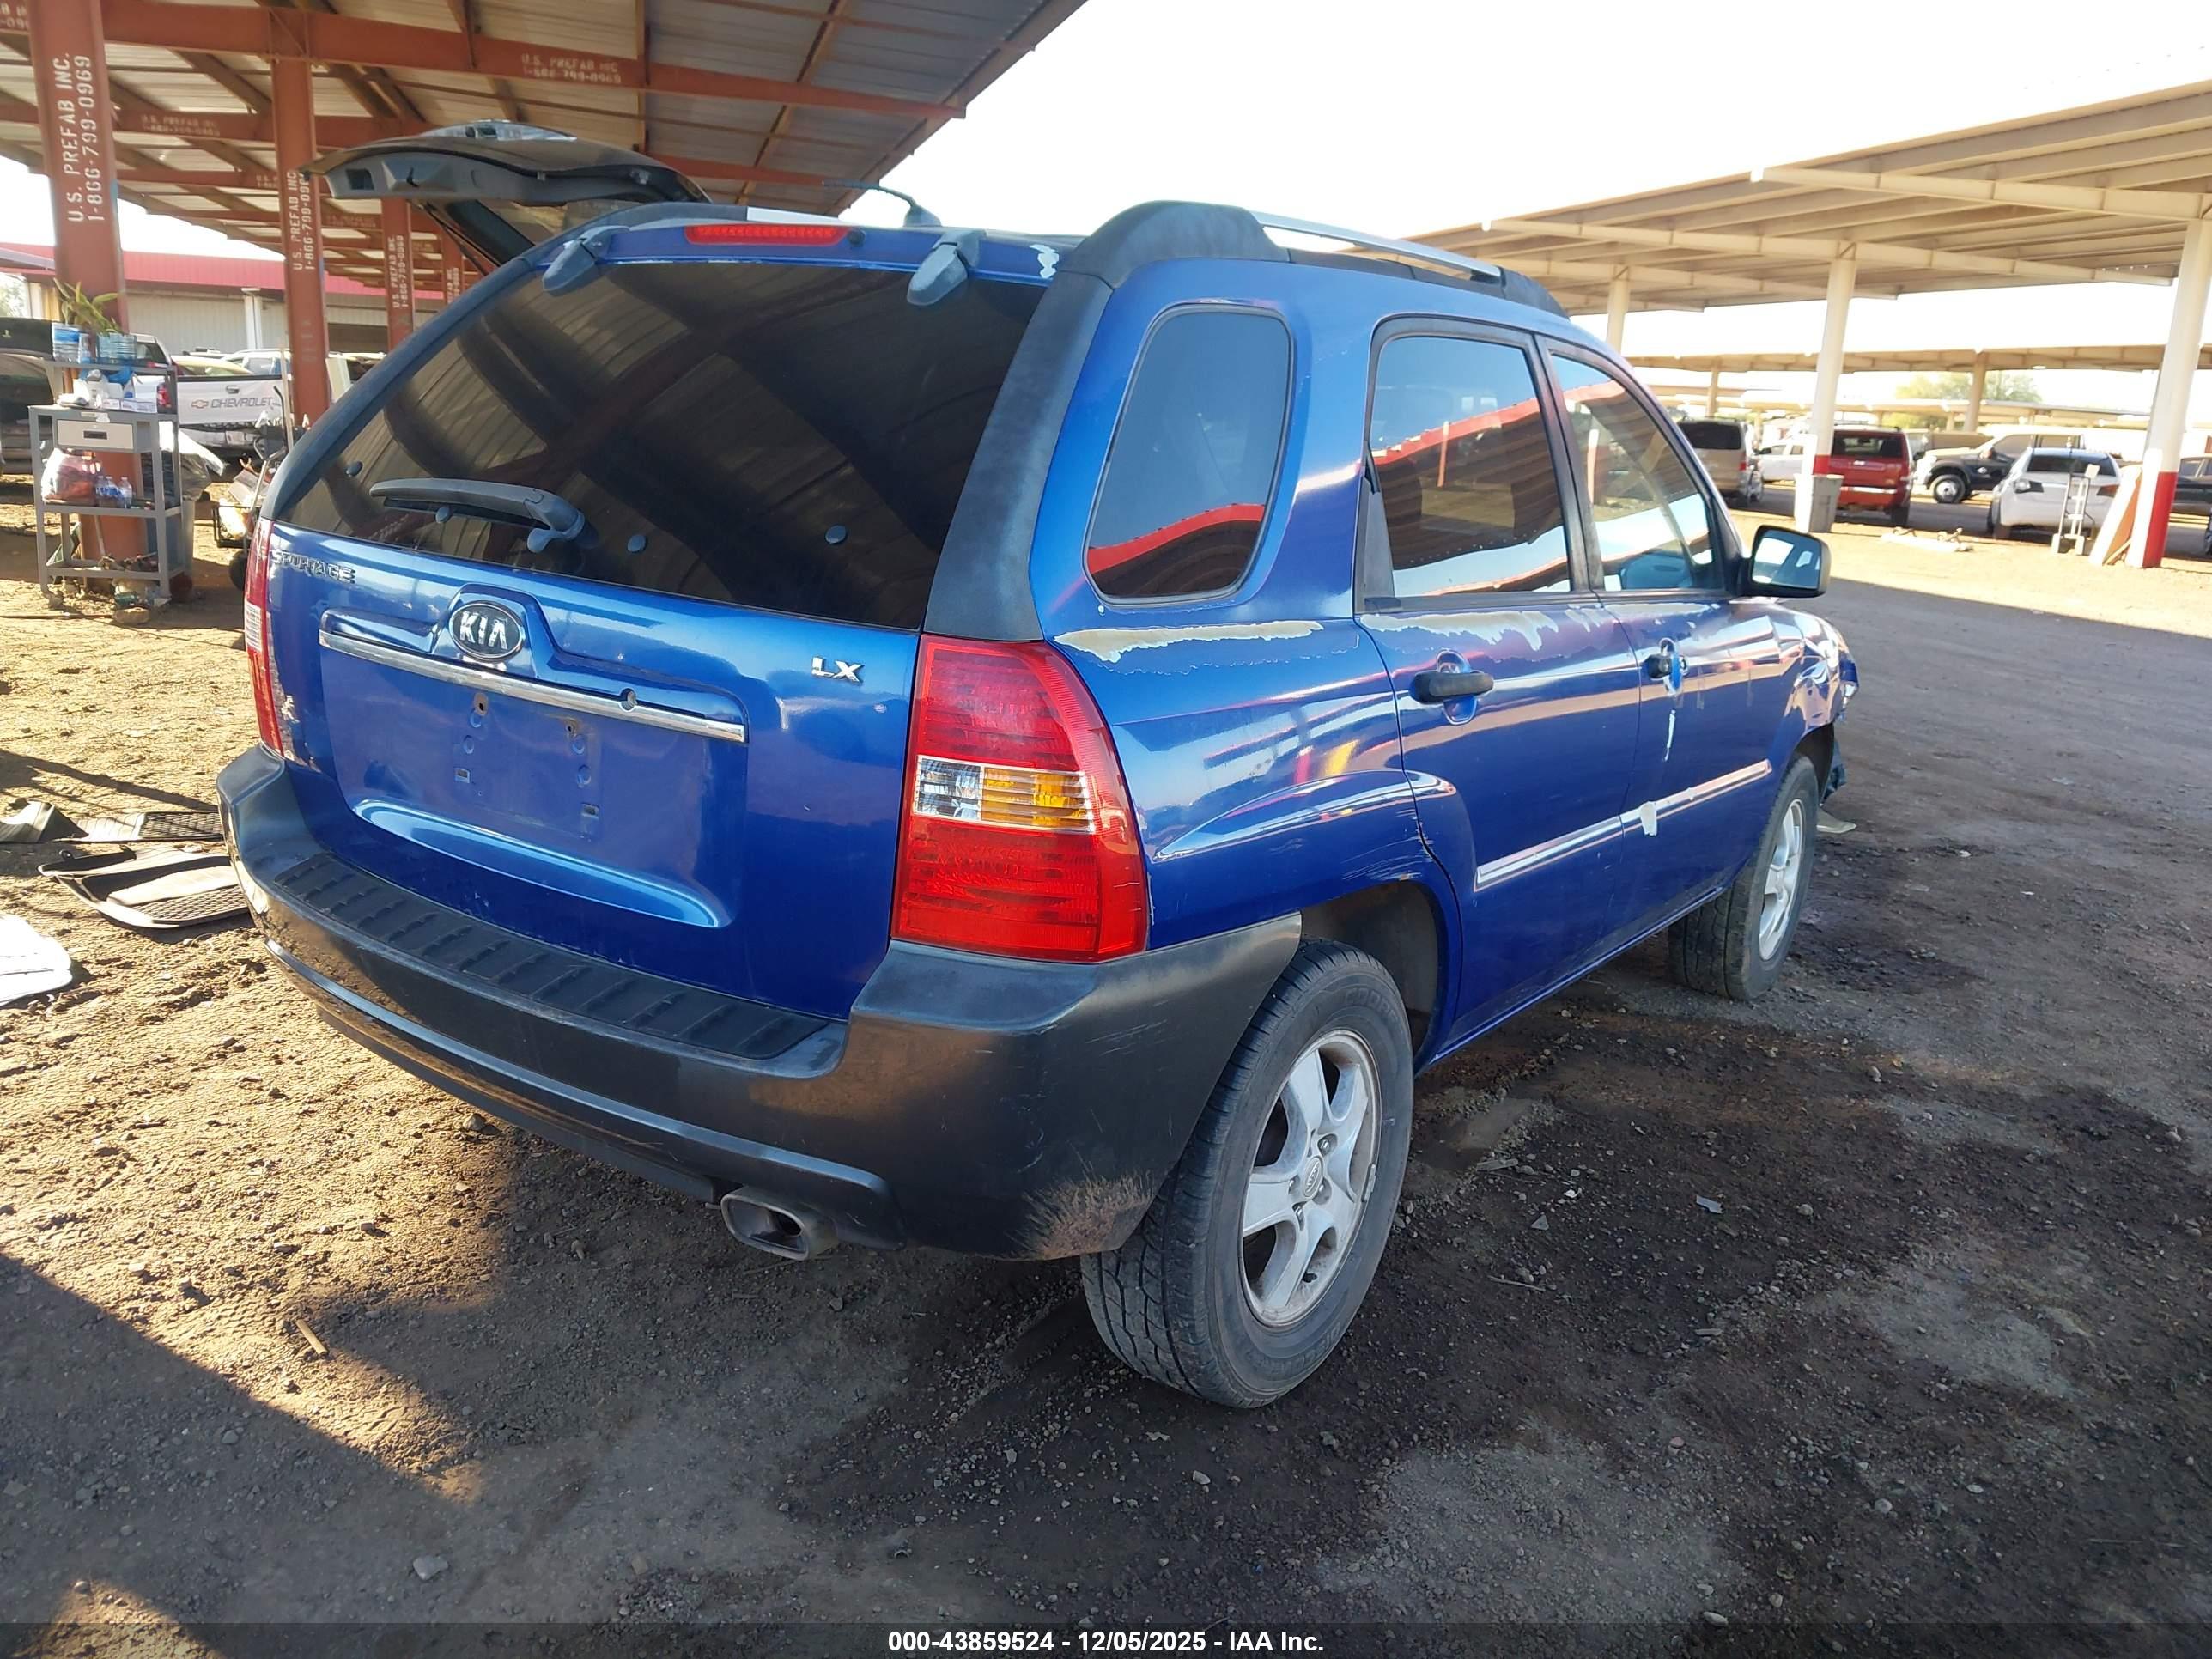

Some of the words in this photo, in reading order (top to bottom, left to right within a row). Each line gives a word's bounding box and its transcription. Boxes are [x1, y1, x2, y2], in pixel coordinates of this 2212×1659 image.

[52, 52, 73, 89] INC.
[57, 100, 81, 175] PREFAB
[74, 55, 105, 221] 1-866-799-0969
[65, 186, 84, 222] U.S.
[288, 196, 301, 242] PREFAB
[210, 397, 273, 409] CHEVROLET
[270, 548, 356, 585] SPORTAGE
[459, 611, 508, 650] KIA
[811, 656, 865, 684] LX
